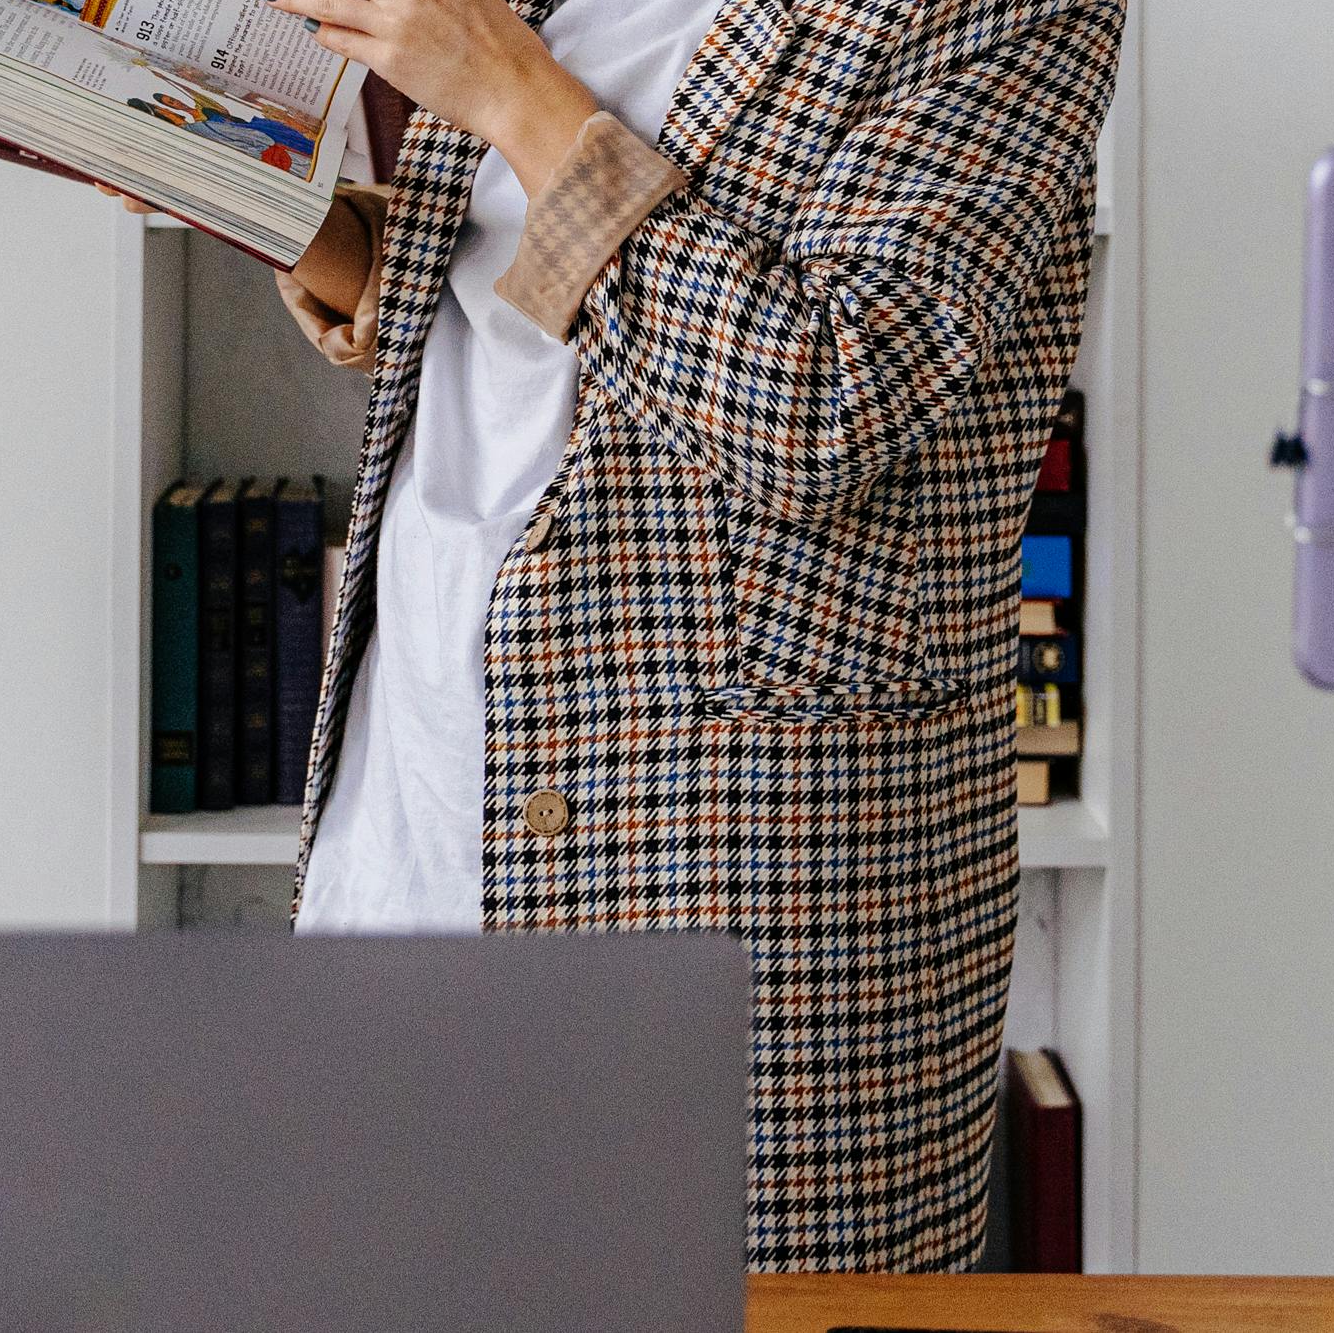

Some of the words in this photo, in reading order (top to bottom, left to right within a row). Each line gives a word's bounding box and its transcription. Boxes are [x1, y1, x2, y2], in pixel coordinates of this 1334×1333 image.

[135, 19, 155, 42] 913
[150, 8, 160, 20] The
[153, 24, 164, 41] close
[159, 2, 172, 23] female
[159, 30, 172, 49] sister
[167, 21, 175, 29] or
[209, 47, 229, 70] 914
[225, 22, 241, 50] Officials
[235, 3, 248, 22] called
[225, 53, 239, 75] helped
[233, 43, 242, 53] the
[239, 17, 254, 43] pharaoh
[248, 8, 255, 16] to
[233, 56, 248, 78] Egypt.
